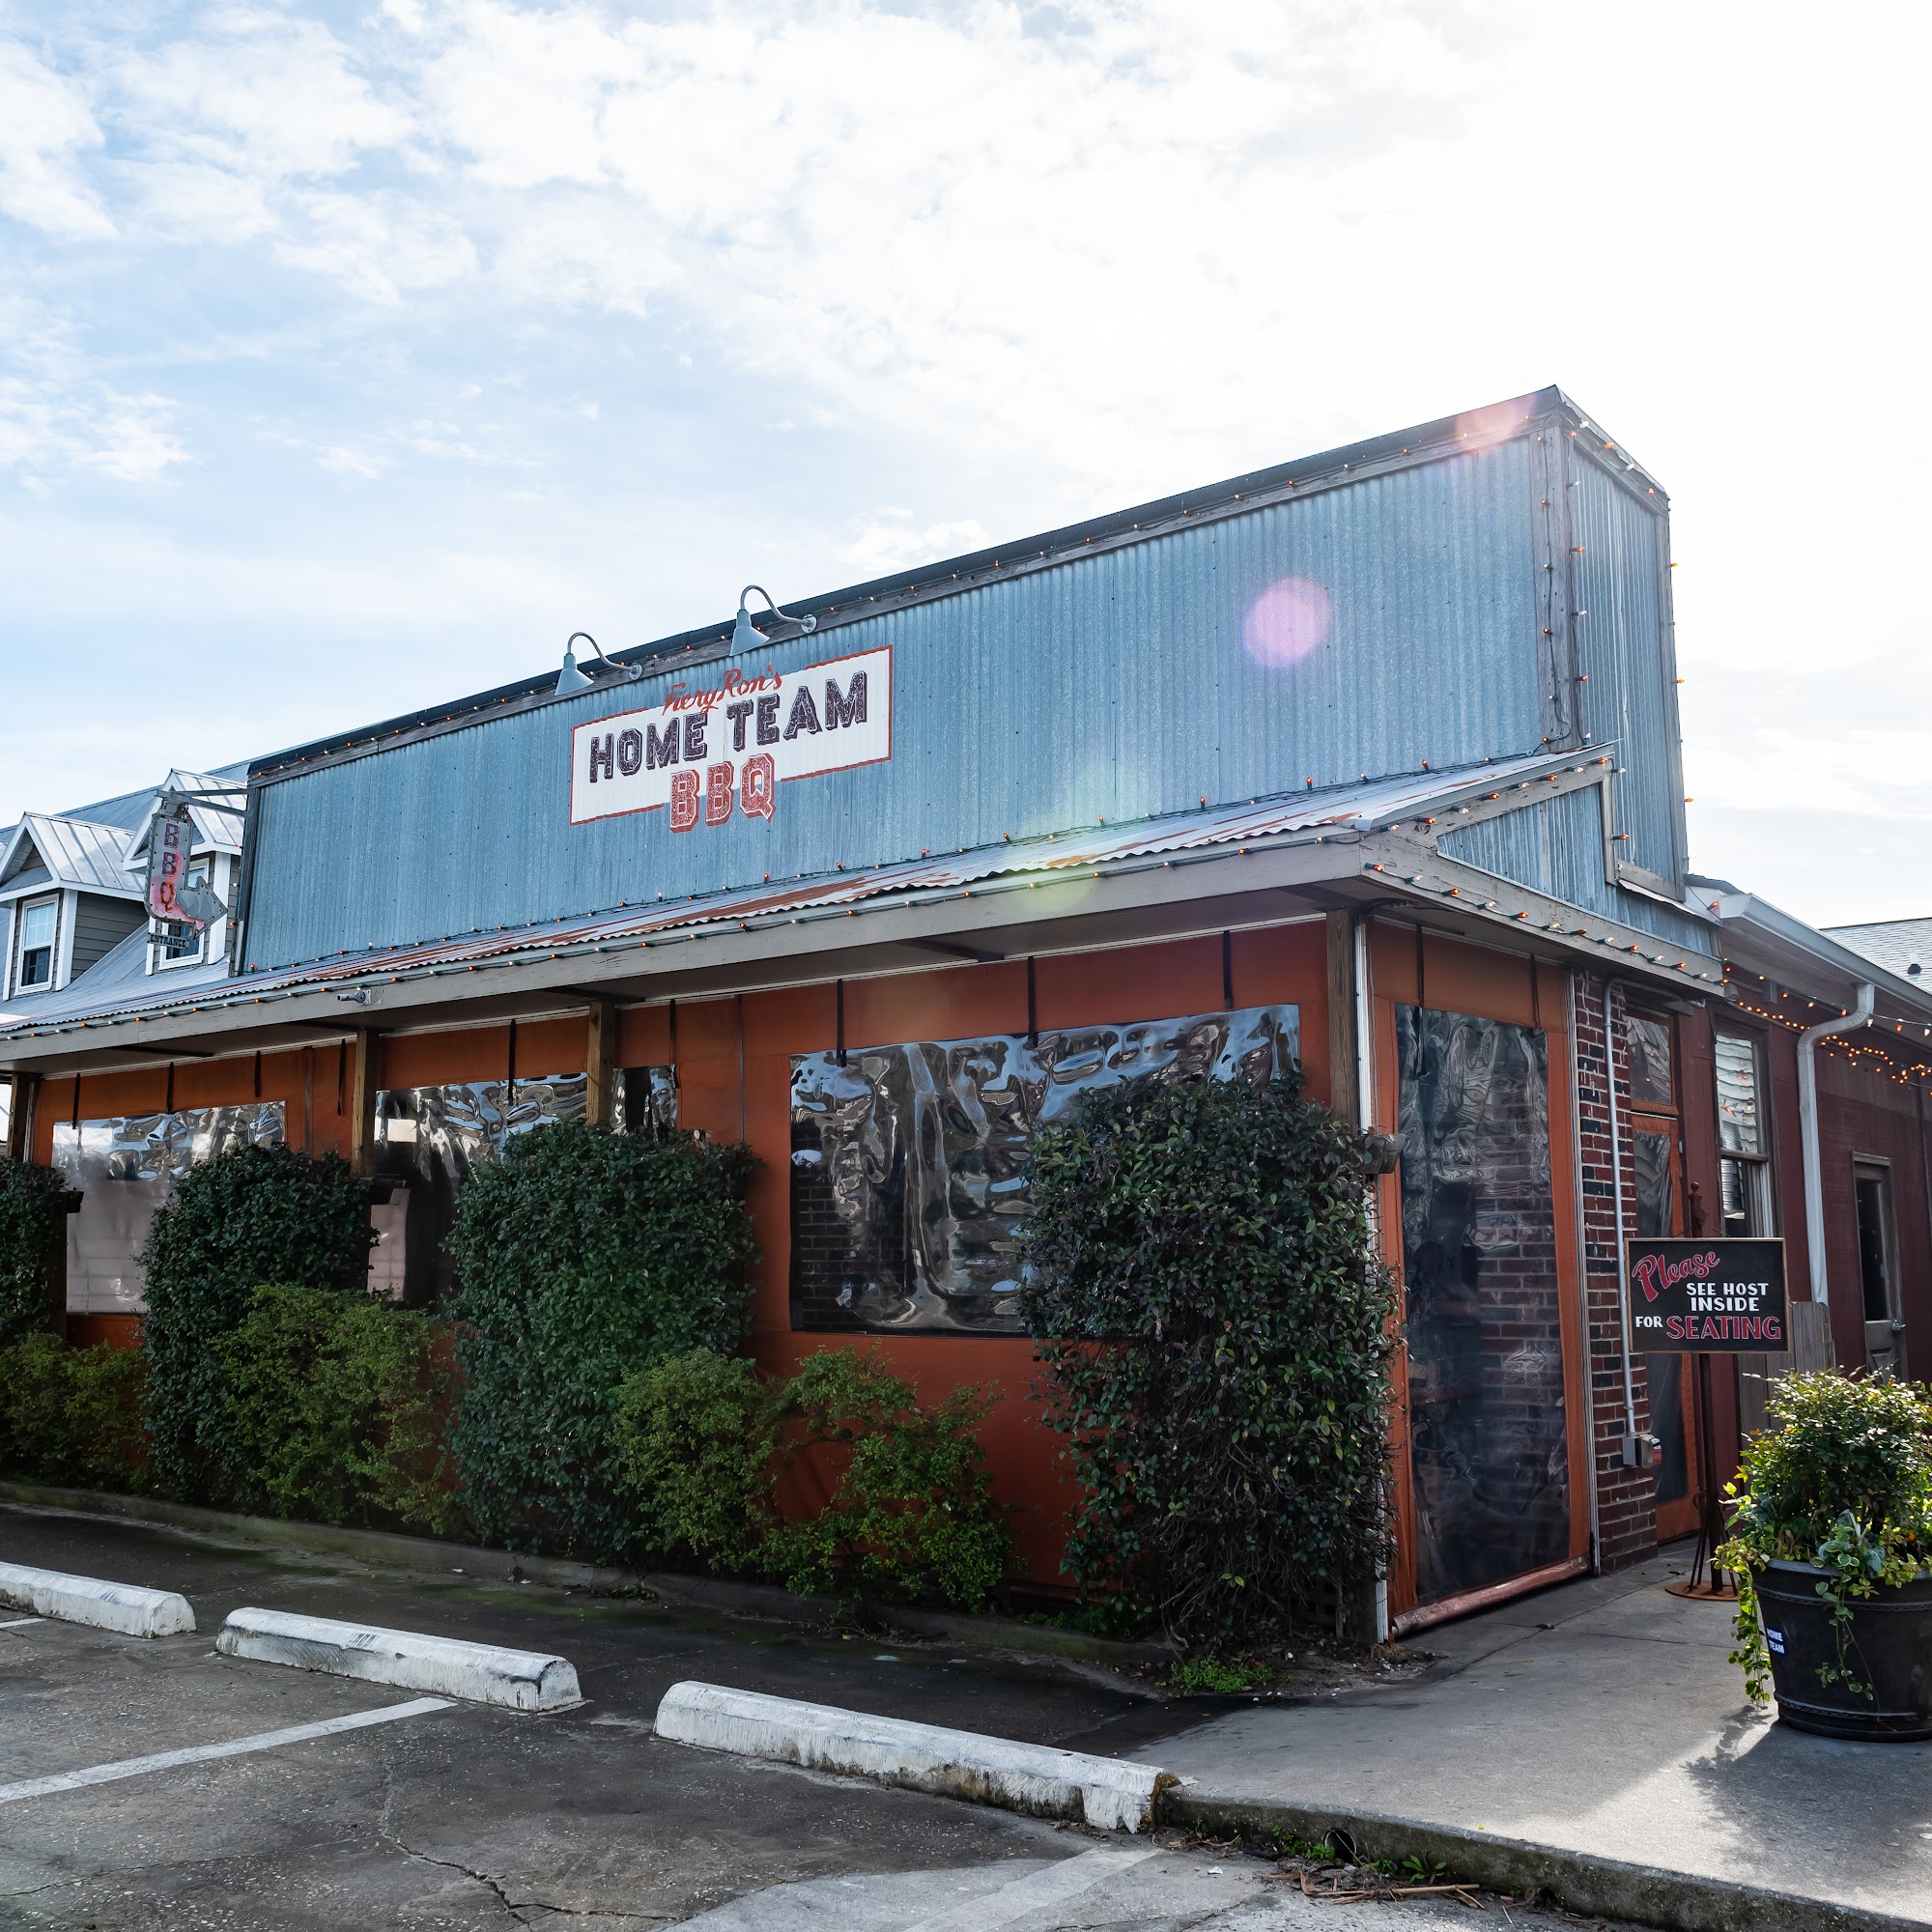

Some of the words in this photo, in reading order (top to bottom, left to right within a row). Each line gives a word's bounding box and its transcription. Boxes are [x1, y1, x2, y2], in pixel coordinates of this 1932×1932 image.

[662, 682, 719, 716] Fiery
[717, 664, 782, 702] Ron's
[589, 713, 708, 783] HOME
[726, 669, 867, 752] TEAM
[669, 753, 777, 834] BBQ
[160, 822, 181, 913] BBQ
[150, 934, 186, 948] ENTRANCE
[1632, 1251, 1720, 1302] Please
[1686, 1283, 1717, 1295] SEE
[1723, 1283, 1769, 1295] HOST
[1690, 1297, 1760, 1312] INSIDE
[1635, 1316, 1663, 1328] FOR
[1666, 1316, 1781, 1340] SEATING
[1766, 1628, 1783, 1641] HOME
[1769, 1639, 1785, 1654] TEAM
